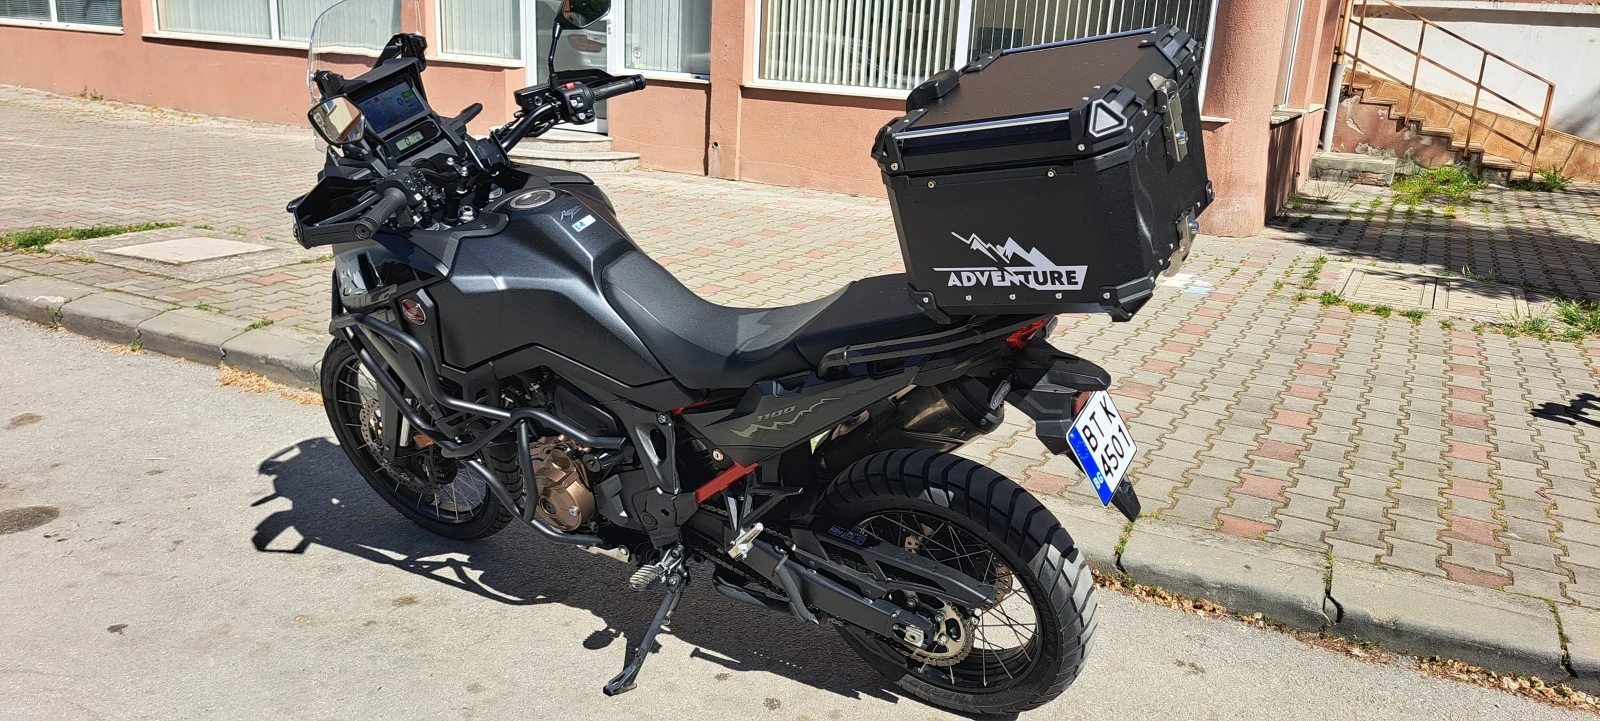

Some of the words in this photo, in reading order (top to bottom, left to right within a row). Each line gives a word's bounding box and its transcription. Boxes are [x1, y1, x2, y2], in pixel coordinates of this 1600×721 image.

[947, 270, 1079, 287] ADVENTURE
[756, 405, 796, 421] 1100
[1082, 411, 1104, 453] BT
[1099, 395, 1116, 424] K
[1101, 424, 1131, 478] 4501
[1093, 471, 1104, 490] BG
[1024, 575, 1056, 642] METZELER
